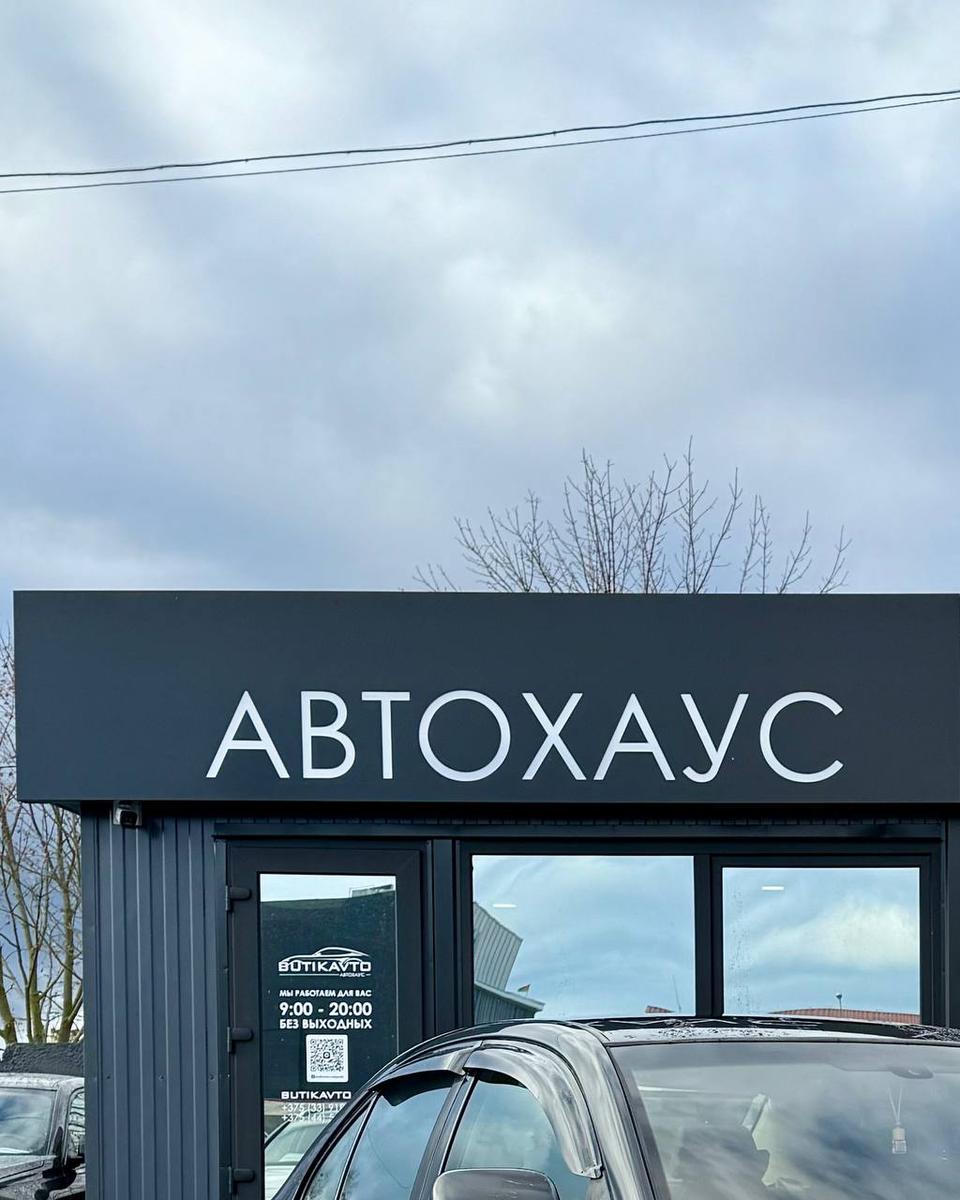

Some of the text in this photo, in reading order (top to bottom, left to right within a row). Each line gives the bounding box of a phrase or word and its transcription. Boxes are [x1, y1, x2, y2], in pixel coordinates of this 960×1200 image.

[206, 690, 844, 783] АВТОХАУС
[278, 961, 371, 972] BUTIKAVTO
[337, 990, 354, 998] ДЛЯ
[279, 1002, 313, 1016] 9:00
[328, 1002, 373, 1016] 20:00
[279, 1019, 373, 1030] БЕЗ ВЫХОДНЫХ
